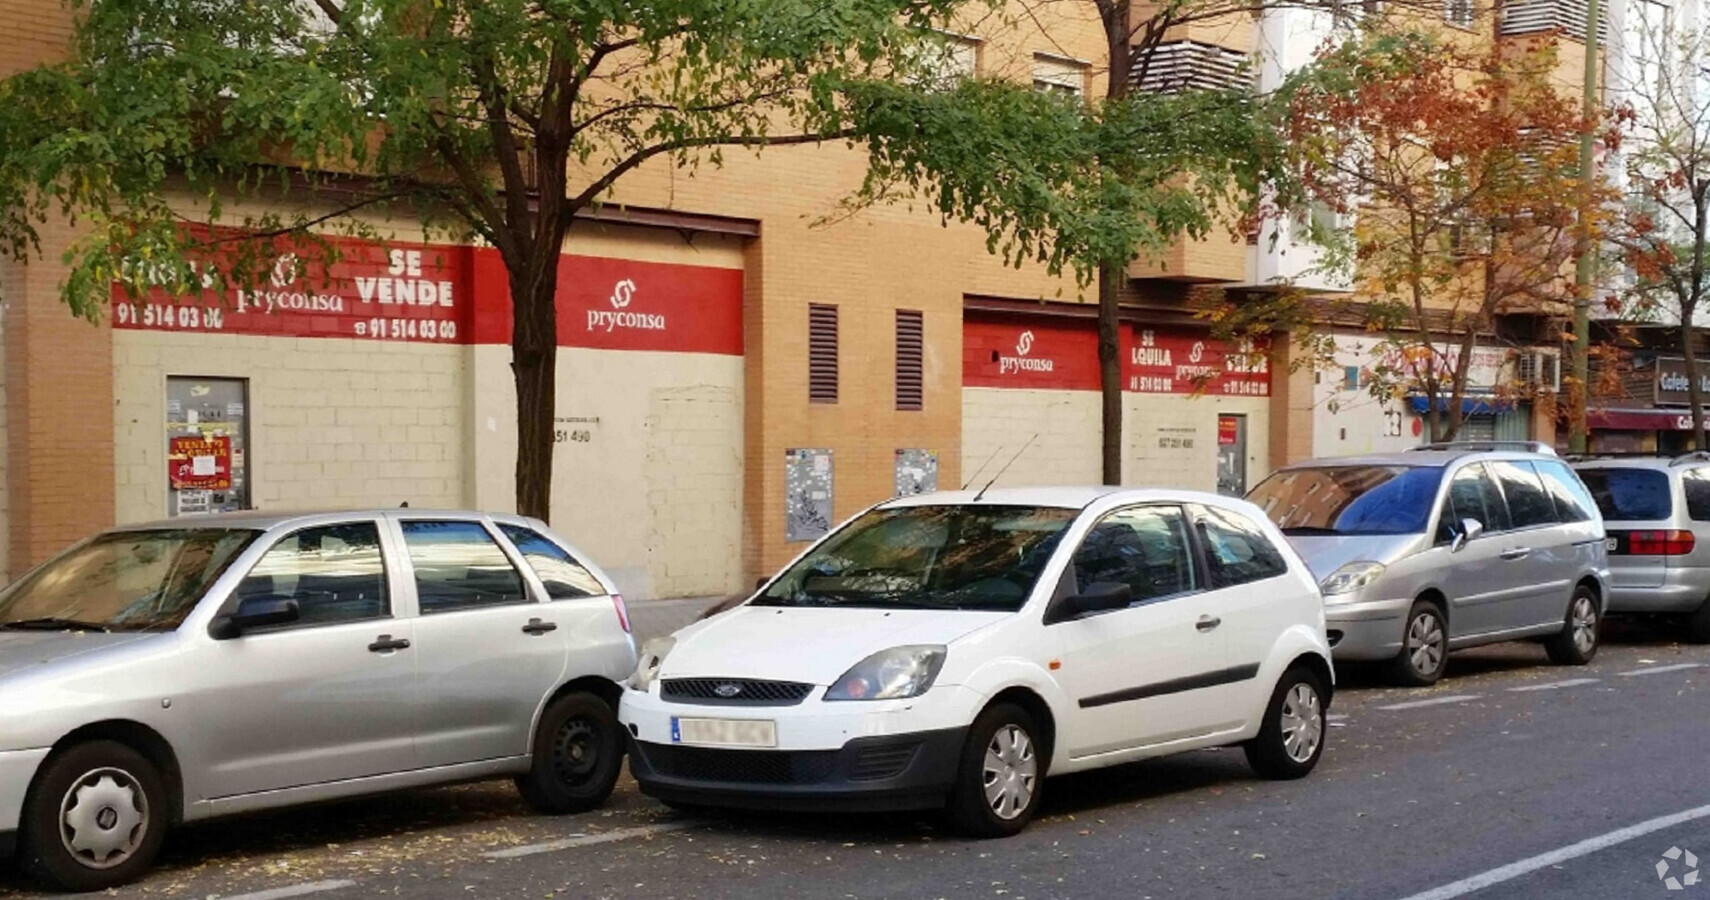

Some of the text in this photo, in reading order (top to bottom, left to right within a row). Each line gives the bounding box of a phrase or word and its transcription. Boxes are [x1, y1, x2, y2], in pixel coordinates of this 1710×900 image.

[388, 249, 422, 277] SE
[236, 289, 344, 314] pryconsa
[354, 276, 454, 307] VENDE
[118, 303, 136, 324] 91
[144, 303, 174, 326] 514
[179, 306, 199, 327] 03
[586, 309, 666, 332] pryconsa
[369, 319, 456, 339] 91 514 03 00
[999, 356, 1053, 374] pryconsa
